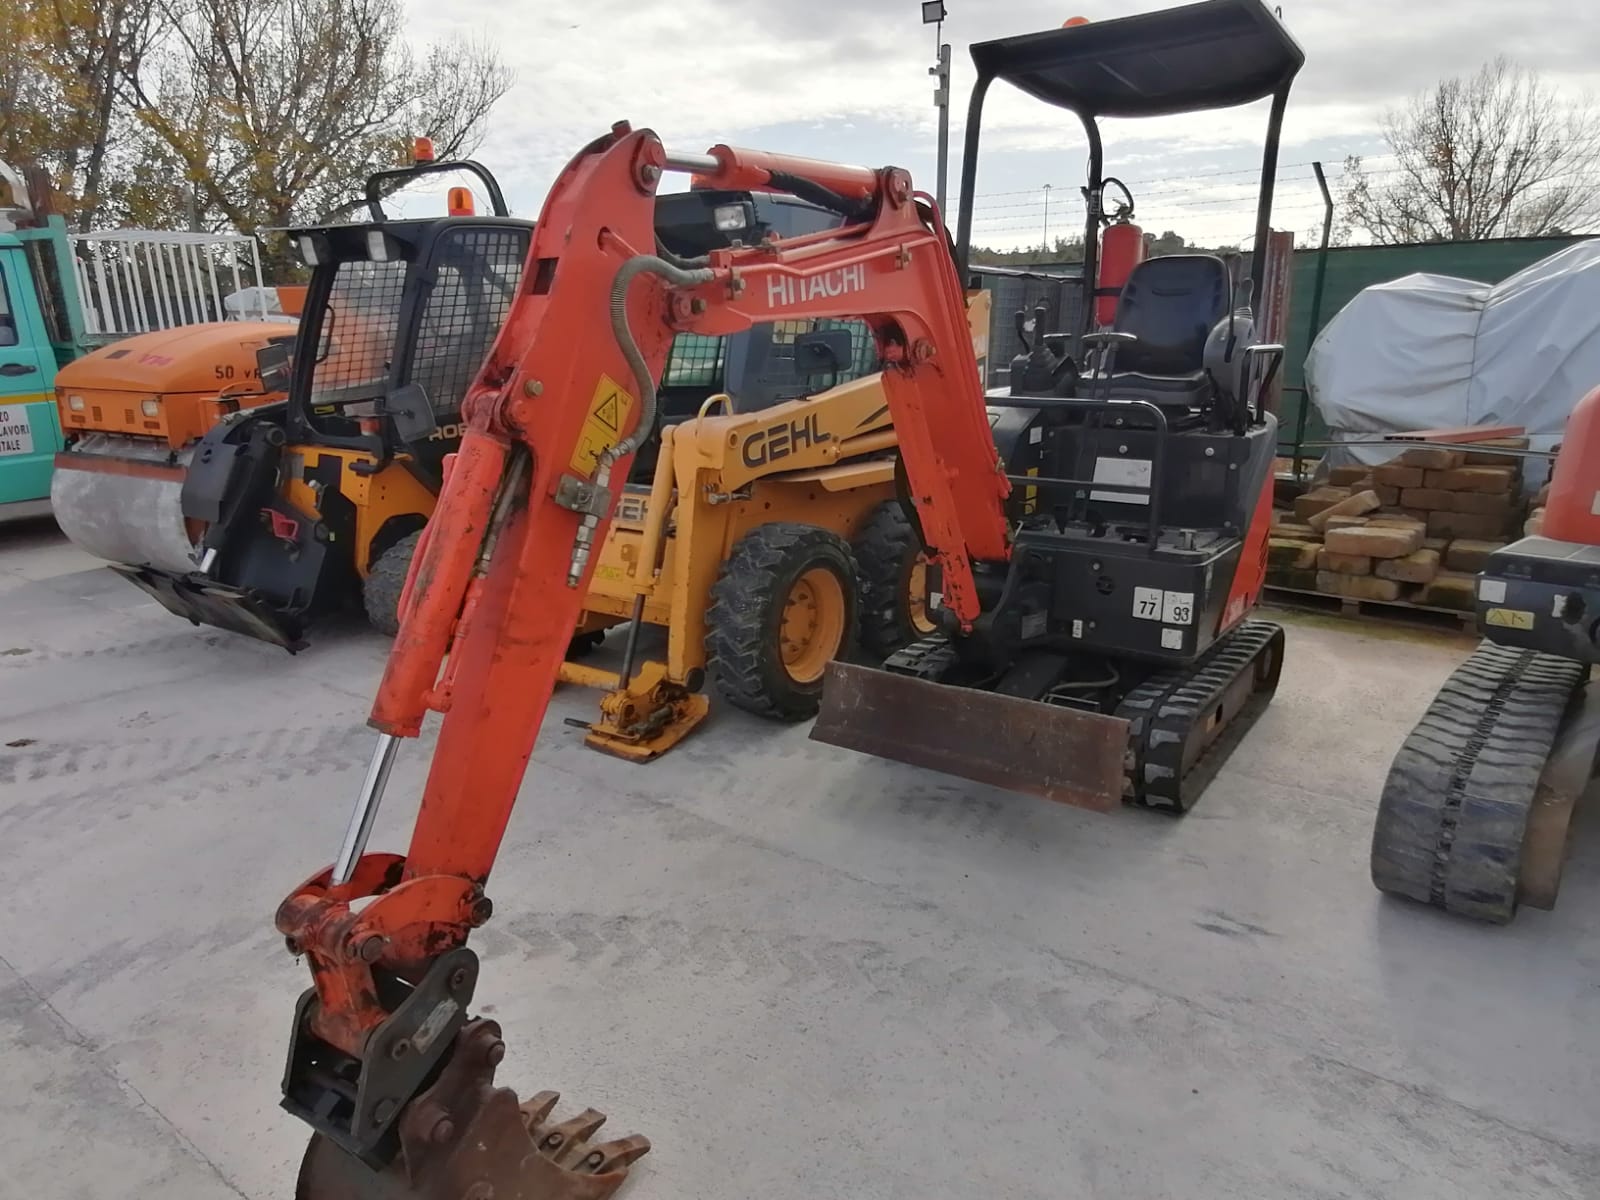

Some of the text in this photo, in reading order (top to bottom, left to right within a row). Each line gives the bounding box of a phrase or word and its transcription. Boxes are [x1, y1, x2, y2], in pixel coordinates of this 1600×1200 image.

[766, 263, 865, 308] HITACHI
[215, 365, 234, 379] 50
[0, 440, 21, 451] TALE
[742, 412, 831, 468] GEHL
[1139, 601, 1190, 622] 77 93
